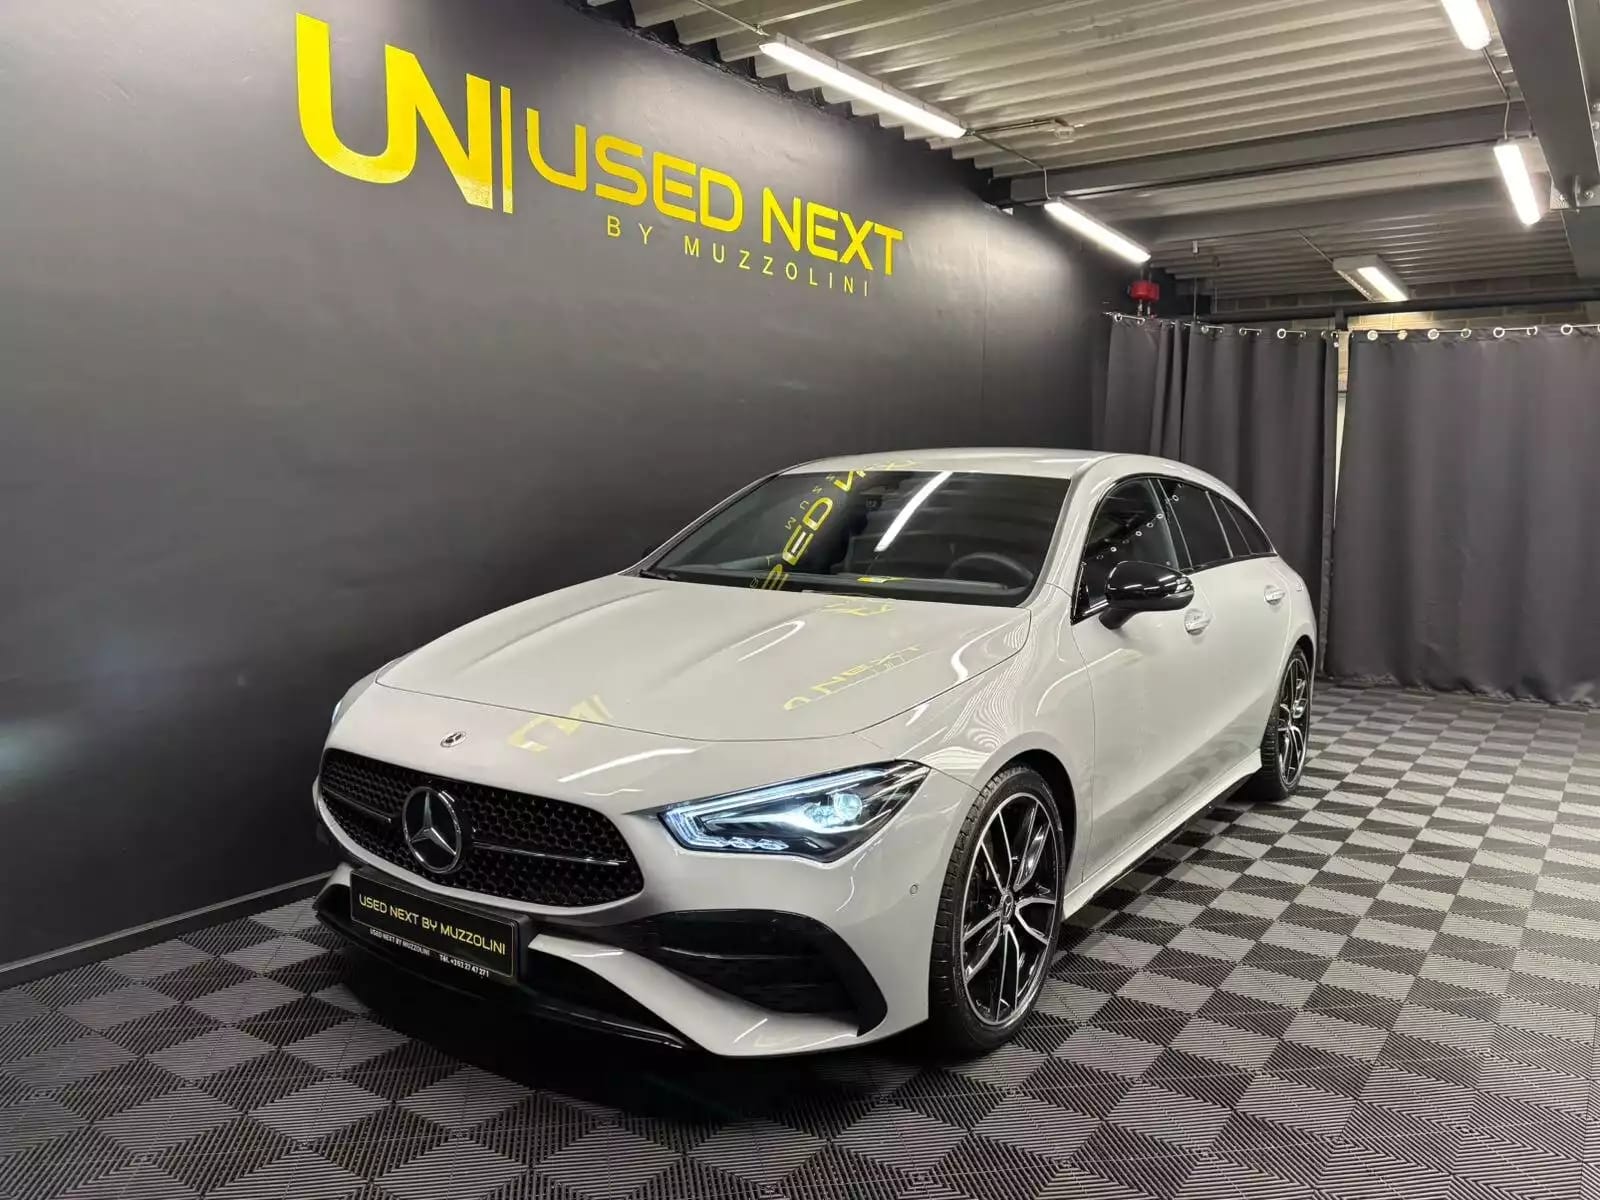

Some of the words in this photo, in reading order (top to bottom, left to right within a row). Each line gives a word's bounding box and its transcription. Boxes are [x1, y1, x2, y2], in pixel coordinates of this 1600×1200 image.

[295, 12, 493, 210] UN
[526, 108, 743, 233] USED
[762, 187, 904, 276] NEXT
[606, 215, 653, 245] BY
[683, 235, 868, 297] MUZZOLINI
[358, 893, 387, 914] USED
[389, 905, 419, 926] NEXT
[421, 916, 438, 932] BY
[440, 922, 506, 956] MUZZOLINI
[369, 927, 382, 938] USED
[382, 932, 396, 943] NEXT
[395, 936, 403, 946] BY
[402, 940, 431, 956] MUZZOLINI
